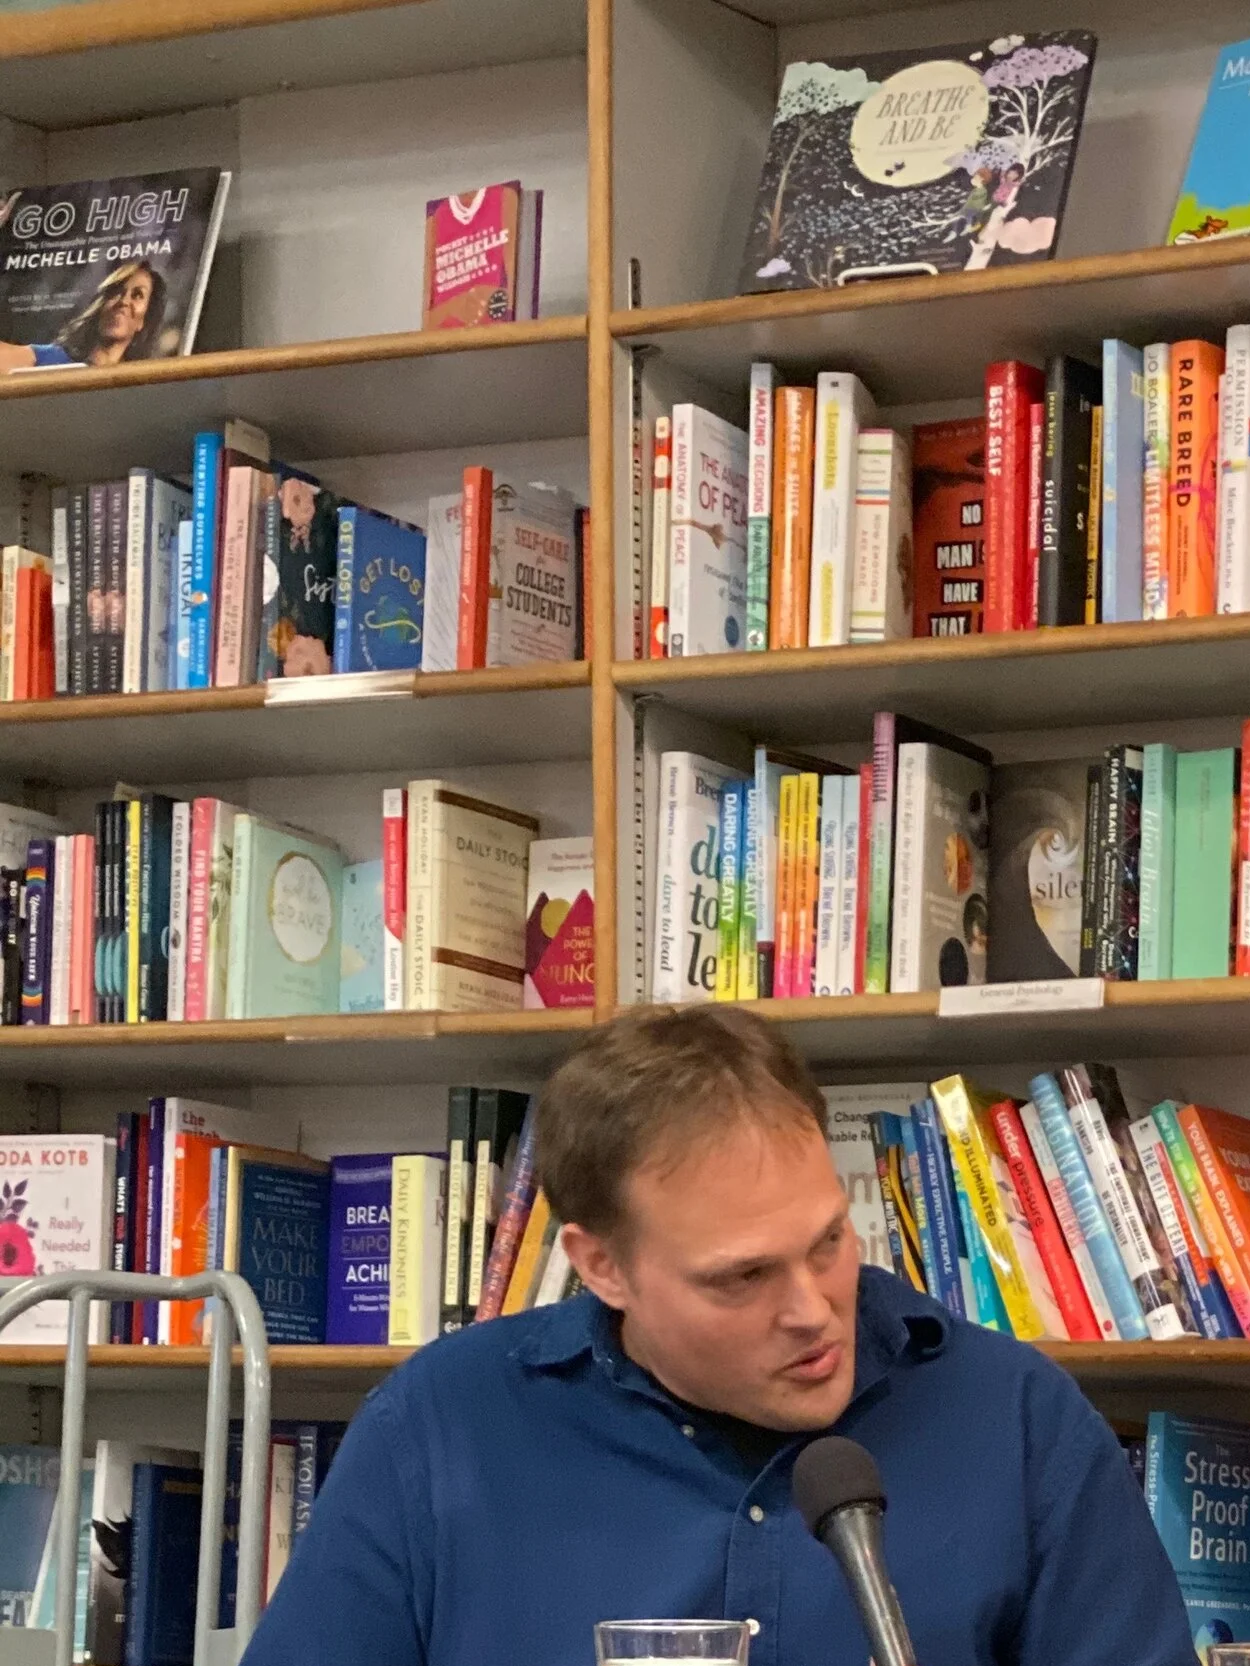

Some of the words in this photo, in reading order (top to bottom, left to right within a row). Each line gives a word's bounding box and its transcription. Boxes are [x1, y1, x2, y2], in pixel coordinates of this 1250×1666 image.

[880, 120, 925, 145] AND
[13, 203, 76, 239] GO
[86, 188, 189, 232] HIGH
[6, 249, 99, 270] MICHELLE
[106, 239, 172, 260] OBAMA
[988, 385, 1003, 430] BEST
[1177, 358, 1194, 422] RARE
[1234, 349, 1246, 446] PERMISSION
[754, 389, 767, 447] AMAZING
[677, 443, 688, 500] ANATOMY
[988, 434, 1002, 477] SELF
[1175, 431, 1192, 508] BREED
[962, 504, 981, 526] NO
[1043, 480, 1057, 551] suicidal
[340, 521, 352, 555] GET
[675, 528, 686, 567] PEACE
[937, 545, 973, 568] MAN
[359, 558, 384, 594] GET
[516, 562, 565, 598] COLLEGE
[944, 582, 978, 604] HAVE
[506, 590, 571, 628] STUDENTS
[931, 617, 966, 637] THAT
[1109, 757, 1119, 799] HAPPY
[174, 814, 184, 864] FOLDED
[722, 793, 737, 852] DARING
[1108, 803, 1118, 843] BRAIN
[456, 836, 492, 858] DAILY
[173, 868, 183, 921] WISDOM
[663, 874, 677, 914] dare
[720, 854, 736, 923] GREATLY
[414, 912, 425, 952] DAILY
[661, 917, 673, 933] to
[660, 934, 674, 972] lead
[413, 955, 425, 996] STOIC
[182, 1111, 206, 1127] the
[40, 1150, 89, 1165] KOTB
[999, 1111, 1022, 1158] under
[1014, 1160, 1046, 1228] pressure
[1038, 1084, 1103, 1241] IMAGINATION
[965, 1144, 997, 1228] ILLUMINATED
[1143, 1146, 1157, 1169] THE
[1151, 1171, 1167, 1200] GIFT
[1160, 1201, 1174, 1222] OF
[1167, 1222, 1187, 1255] FEAR
[48, 1216, 84, 1232] Really
[254, 1218, 318, 1243] MAKE
[41, 1240, 91, 1253] Needed
[1191, 1490, 1249, 1527] Proof
[1189, 1528, 1248, 1563] Brain
